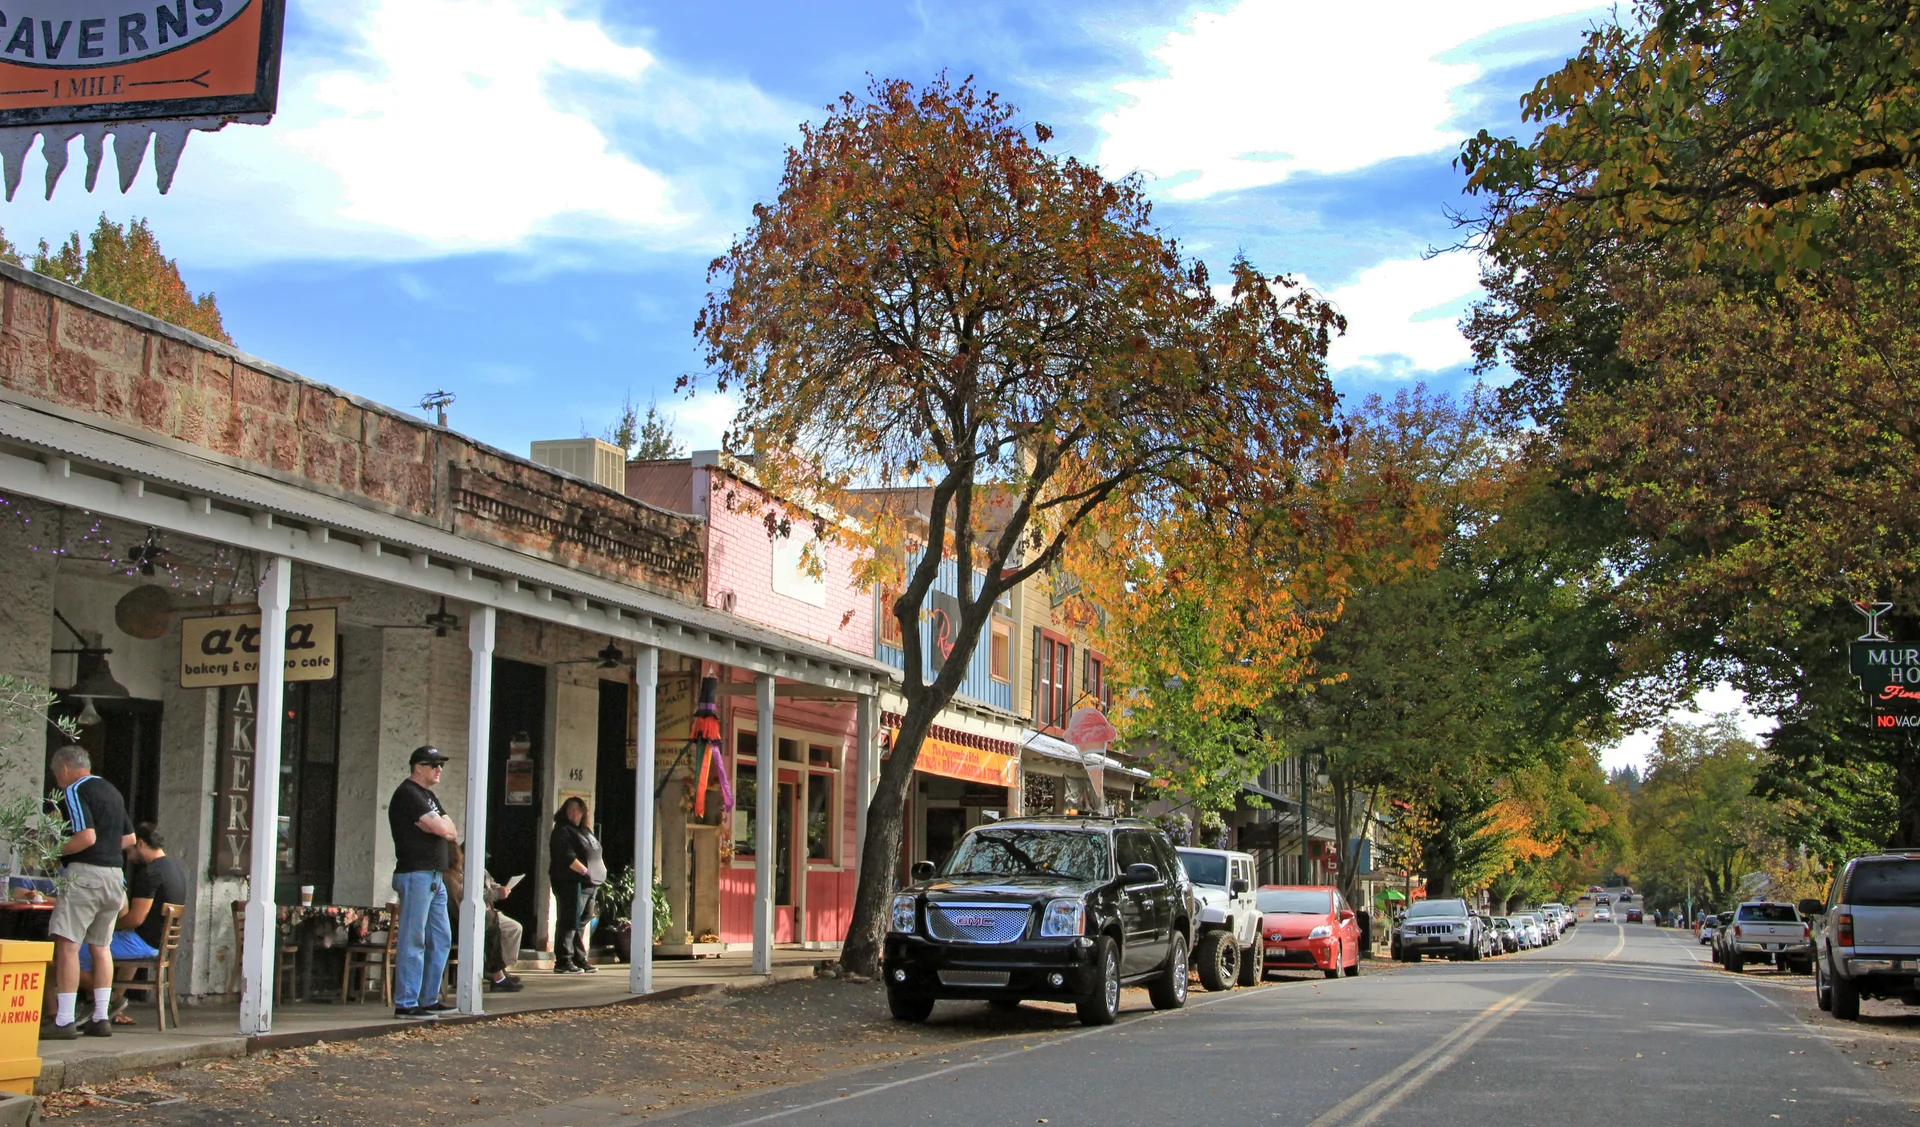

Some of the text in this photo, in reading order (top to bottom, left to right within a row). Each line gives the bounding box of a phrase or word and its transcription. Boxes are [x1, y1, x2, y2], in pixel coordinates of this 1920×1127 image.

[0, 0, 223, 59] AVERNS
[53, 75, 125, 98] 1 MILE
[185, 662, 228, 676] bakery
[232, 661, 240, 672] &
[301, 656, 331, 667] cafe
[226, 685, 255, 870] AKERY
[569, 768, 584, 781] 458
[956, 916, 993, 927] GMC
[3, 973, 39, 991] FIRE
[11, 995, 24, 1007] NO
[0, 1011, 38, 1024] ARKING
